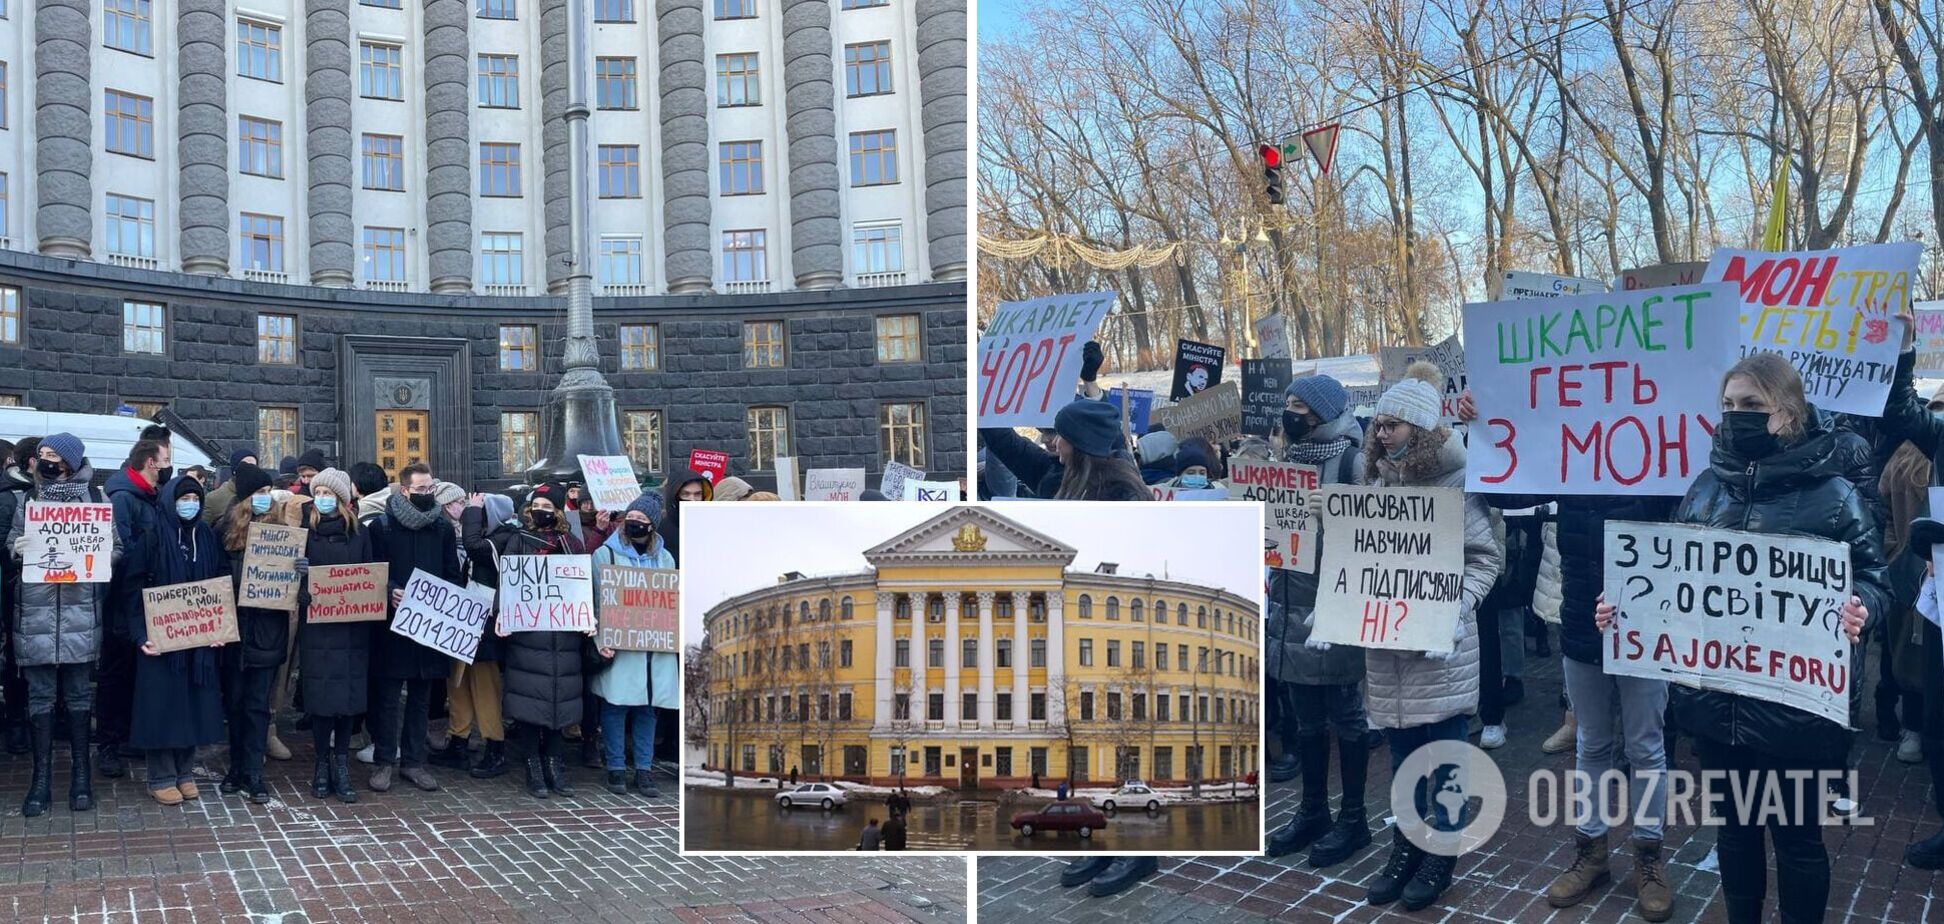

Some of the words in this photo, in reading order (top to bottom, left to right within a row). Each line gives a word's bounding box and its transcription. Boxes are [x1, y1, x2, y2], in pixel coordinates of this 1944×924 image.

[1722, 256, 1908, 311] МОНСТРА
[985, 299, 1106, 337] ШКАРЛЕТ
[1498, 291, 1712, 363] ШКАРЛЕТ
[1181, 343, 1222, 357] СКАСУЙТЕ
[1182, 352, 1218, 366] МІНІСТРА
[1790, 350, 1894, 385] РУЙНУВАТИ
[1531, 361, 1658, 409] ГЕТЬ
[1801, 371, 1850, 399] ВІТУ
[1480, 418, 1518, 483] З
[1231, 464, 1318, 490] ШКАРЛЕТЕ
[1242, 486, 1305, 506] ДОСИТЬ
[1327, 493, 1434, 522] СПИСУВАТИ
[29, 506, 111, 522] ШКАРЛЕТЕ
[1276, 519, 1306, 531] ЧАТИ
[39, 522, 99, 535] ДОСИТЬ
[1354, 528, 1431, 555] НАВЧИЛИ
[71, 544, 101, 553] ЧАТИ
[501, 556, 549, 586] РУКИ
[601, 569, 648, 588] ДУША
[652, 572, 679, 589] СТР
[1334, 567, 1347, 594] А
[1769, 546, 1846, 592] ВИЩУ
[521, 584, 563, 602] ВІД
[602, 588, 618, 606] ЯК
[623, 589, 680, 610] ШКАРЛЕ
[603, 627, 622, 647] БО
[628, 629, 674, 650] ГАРЯЧЕ
